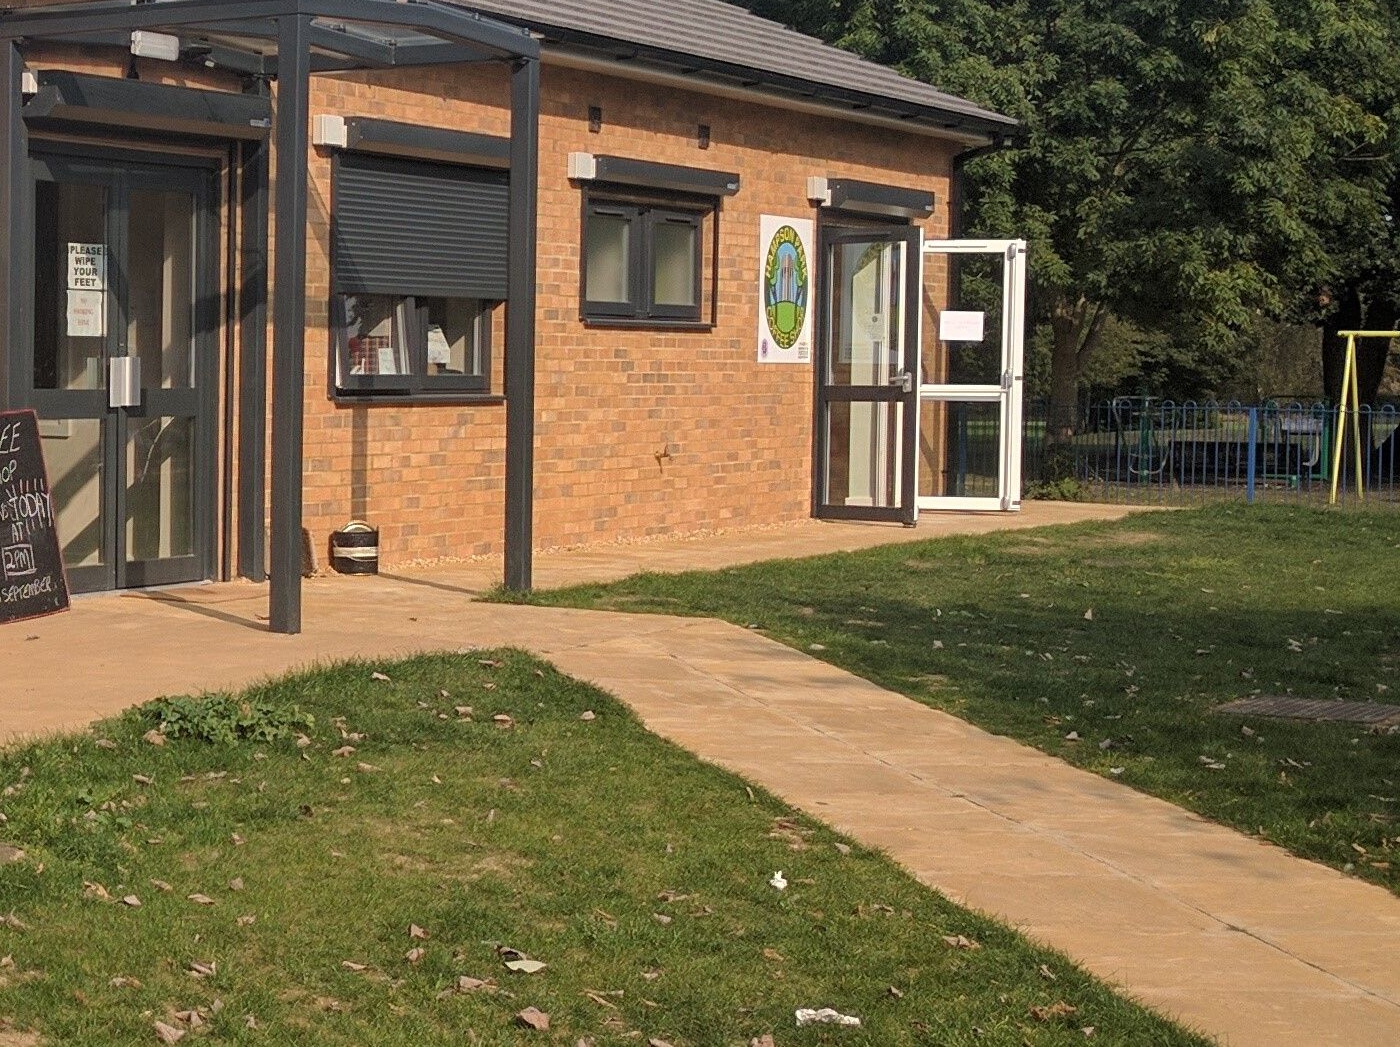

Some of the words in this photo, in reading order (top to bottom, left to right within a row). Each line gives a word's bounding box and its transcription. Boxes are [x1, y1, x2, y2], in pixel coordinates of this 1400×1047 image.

[70, 245, 102, 256] PLEASE
[75, 256, 96, 266] WIPE
[74, 267, 98, 276] YOUR
[75, 278, 96, 287] FEET
[9, 492, 52, 527] TODAY
[12, 521, 24, 543] AT
[5, 549, 31, 570] 2PM
[1, 576, 51, 603] SEPTEMBER
